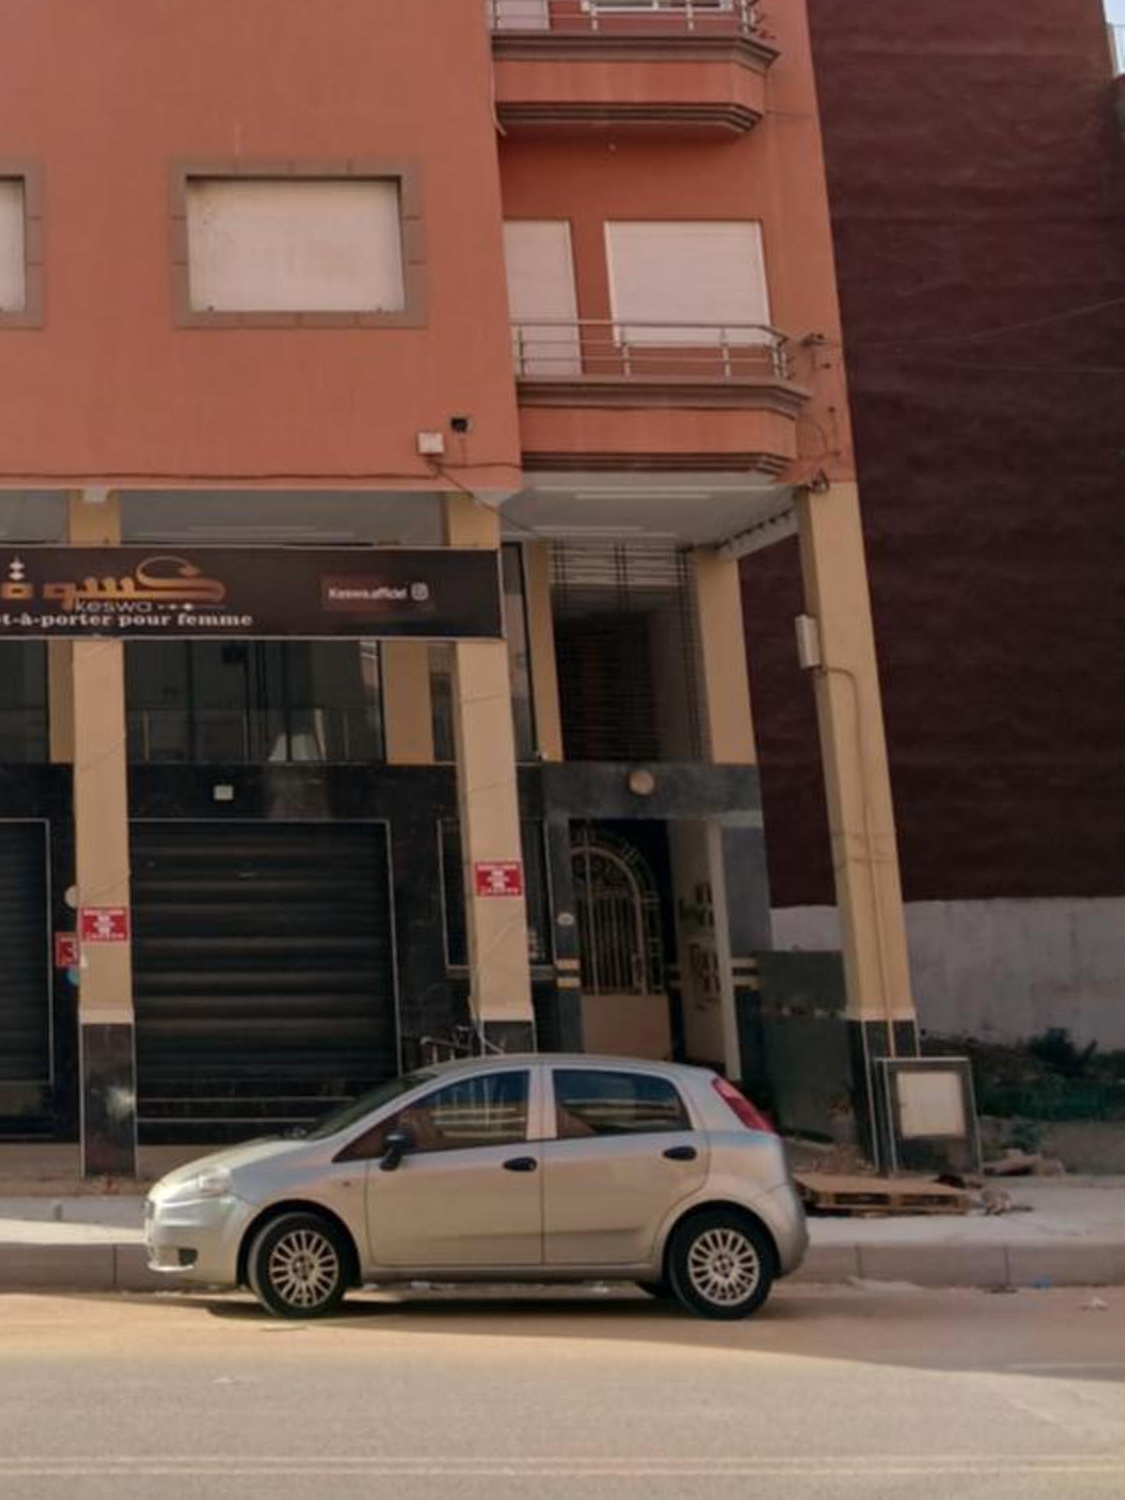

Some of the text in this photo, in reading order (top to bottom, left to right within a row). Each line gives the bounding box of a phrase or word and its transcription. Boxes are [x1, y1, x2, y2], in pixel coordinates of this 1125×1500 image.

[0, 556, 227, 612] كسوة
[119, 613, 172, 628] pour
[177, 612, 253, 627] femme
